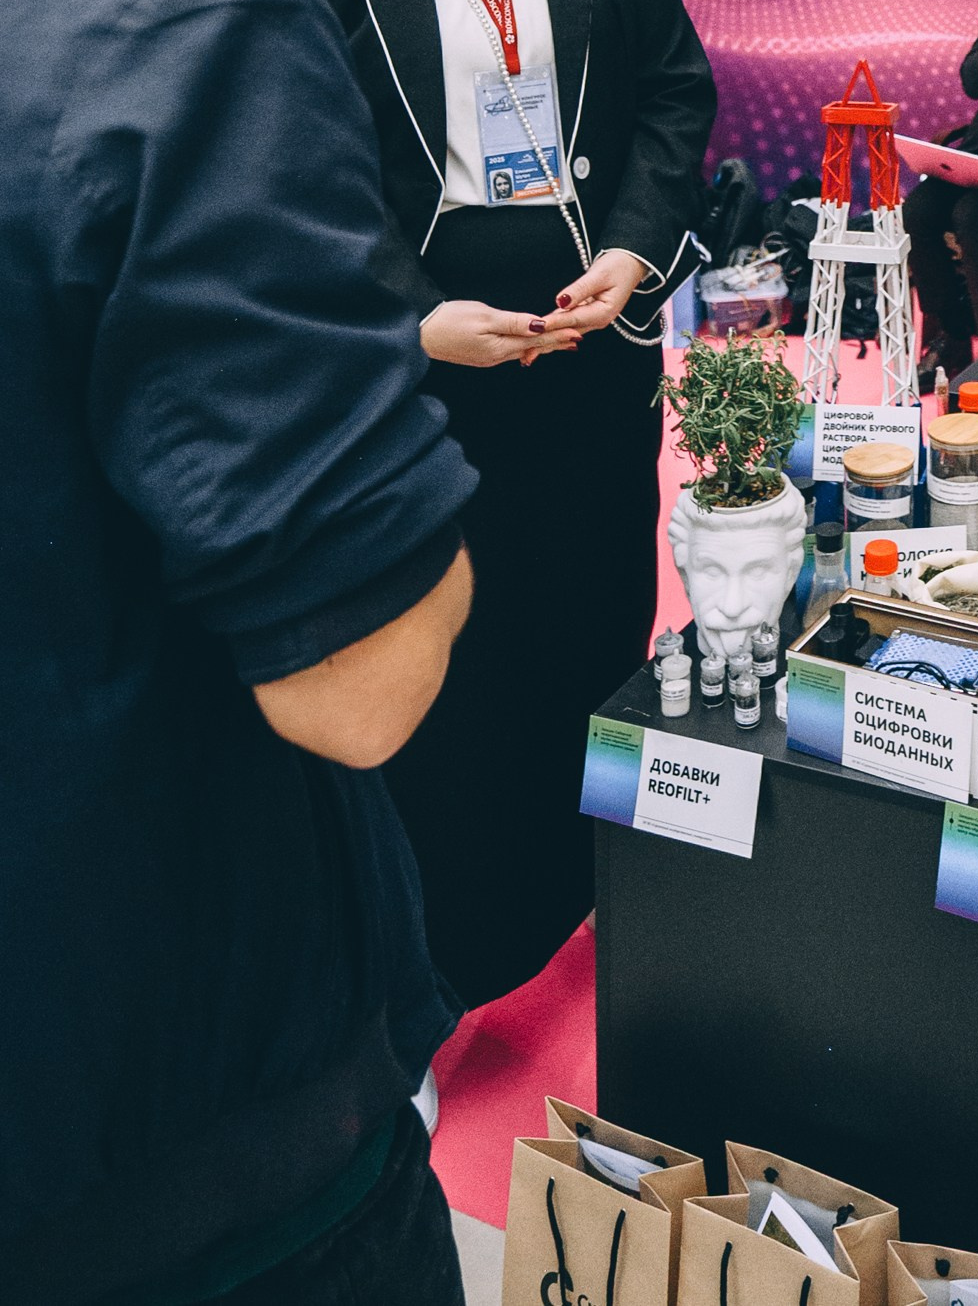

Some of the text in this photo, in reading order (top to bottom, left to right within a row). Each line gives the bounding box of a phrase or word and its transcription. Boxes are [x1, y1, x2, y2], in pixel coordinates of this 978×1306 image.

[823, 411, 874, 421] ЦИФРОВОЙ
[823, 422, 915, 434] ДВОЙНИК БУРОВОГО
[822, 434, 868, 443] РАСТВОРА
[855, 691, 927, 722] СИСТЕМА
[854, 711, 953, 750] ОЦИФРОВКИ
[854, 730, 954, 771] БИОДАННЫХ
[650, 758, 721, 787] ДОБАВКИ
[648, 778, 711, 805] REOFILT+
